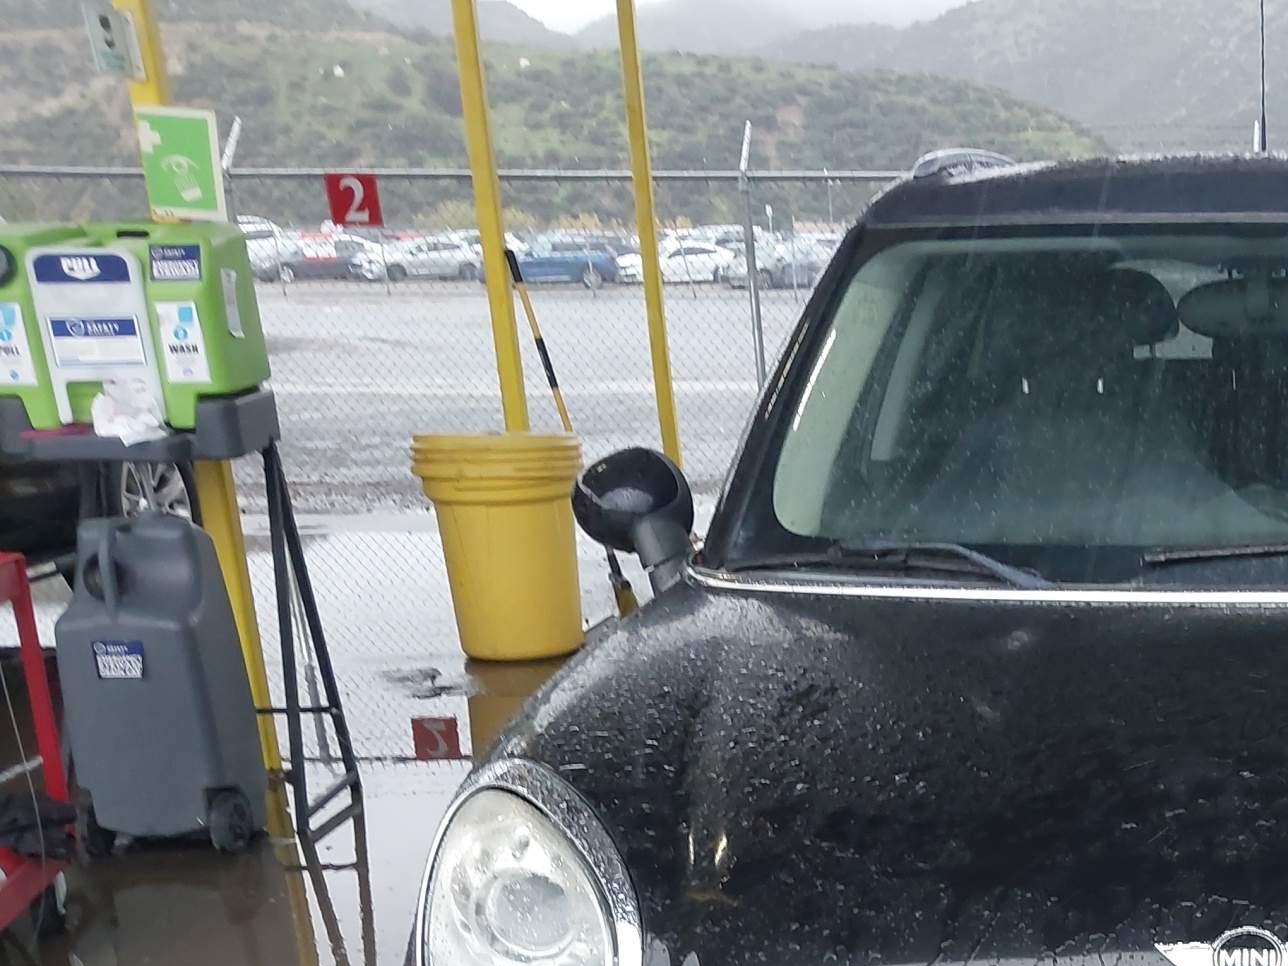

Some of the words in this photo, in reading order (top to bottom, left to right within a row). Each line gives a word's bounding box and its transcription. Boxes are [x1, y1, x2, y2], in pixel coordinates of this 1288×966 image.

[339, 175, 370, 222] 2
[168, 343, 199, 354] WASH
[1219, 949, 1276, 966] MINI
